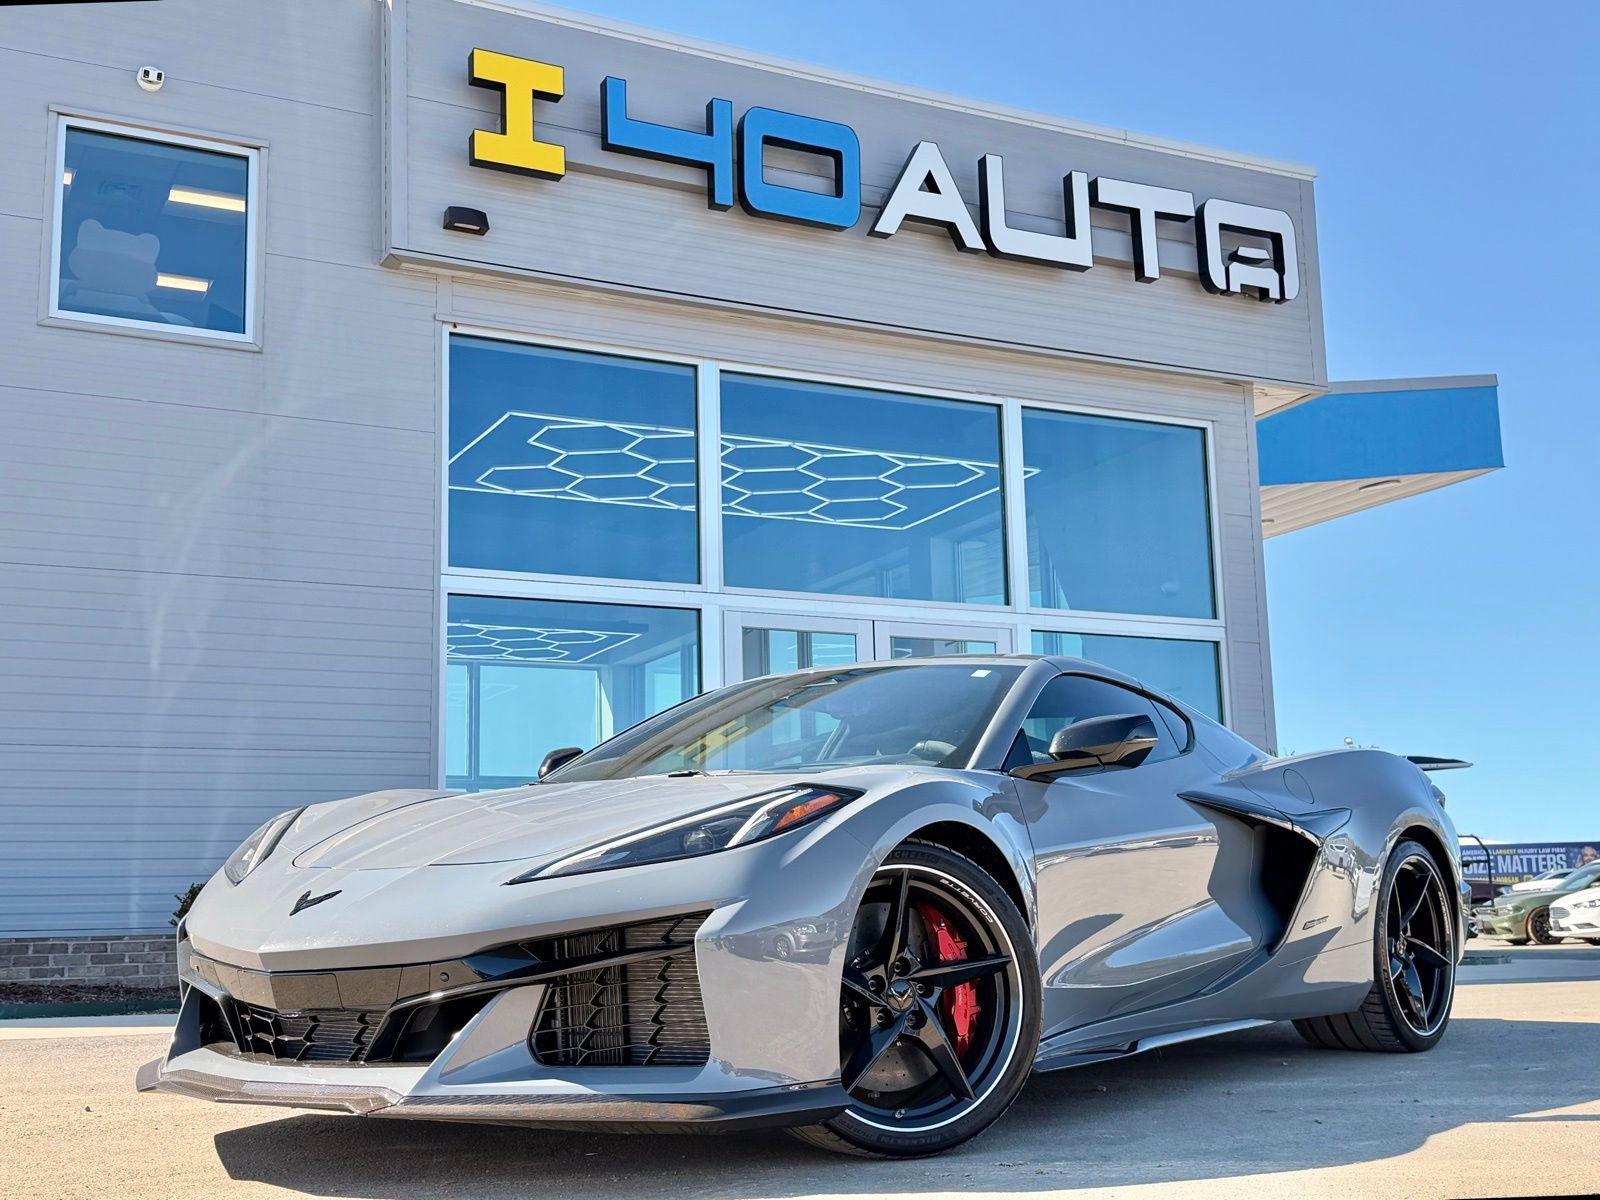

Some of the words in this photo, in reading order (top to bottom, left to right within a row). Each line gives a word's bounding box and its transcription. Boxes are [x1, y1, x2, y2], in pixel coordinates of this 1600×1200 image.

[469, 48, 566, 180] I
[601, 76, 861, 231] 40
[888, 850, 940, 863] ICHELIN
[1462, 856, 1495, 875] SIZE
[1497, 853, 1567, 873] MATTERS
[939, 878, 994, 923] CORVETTE
